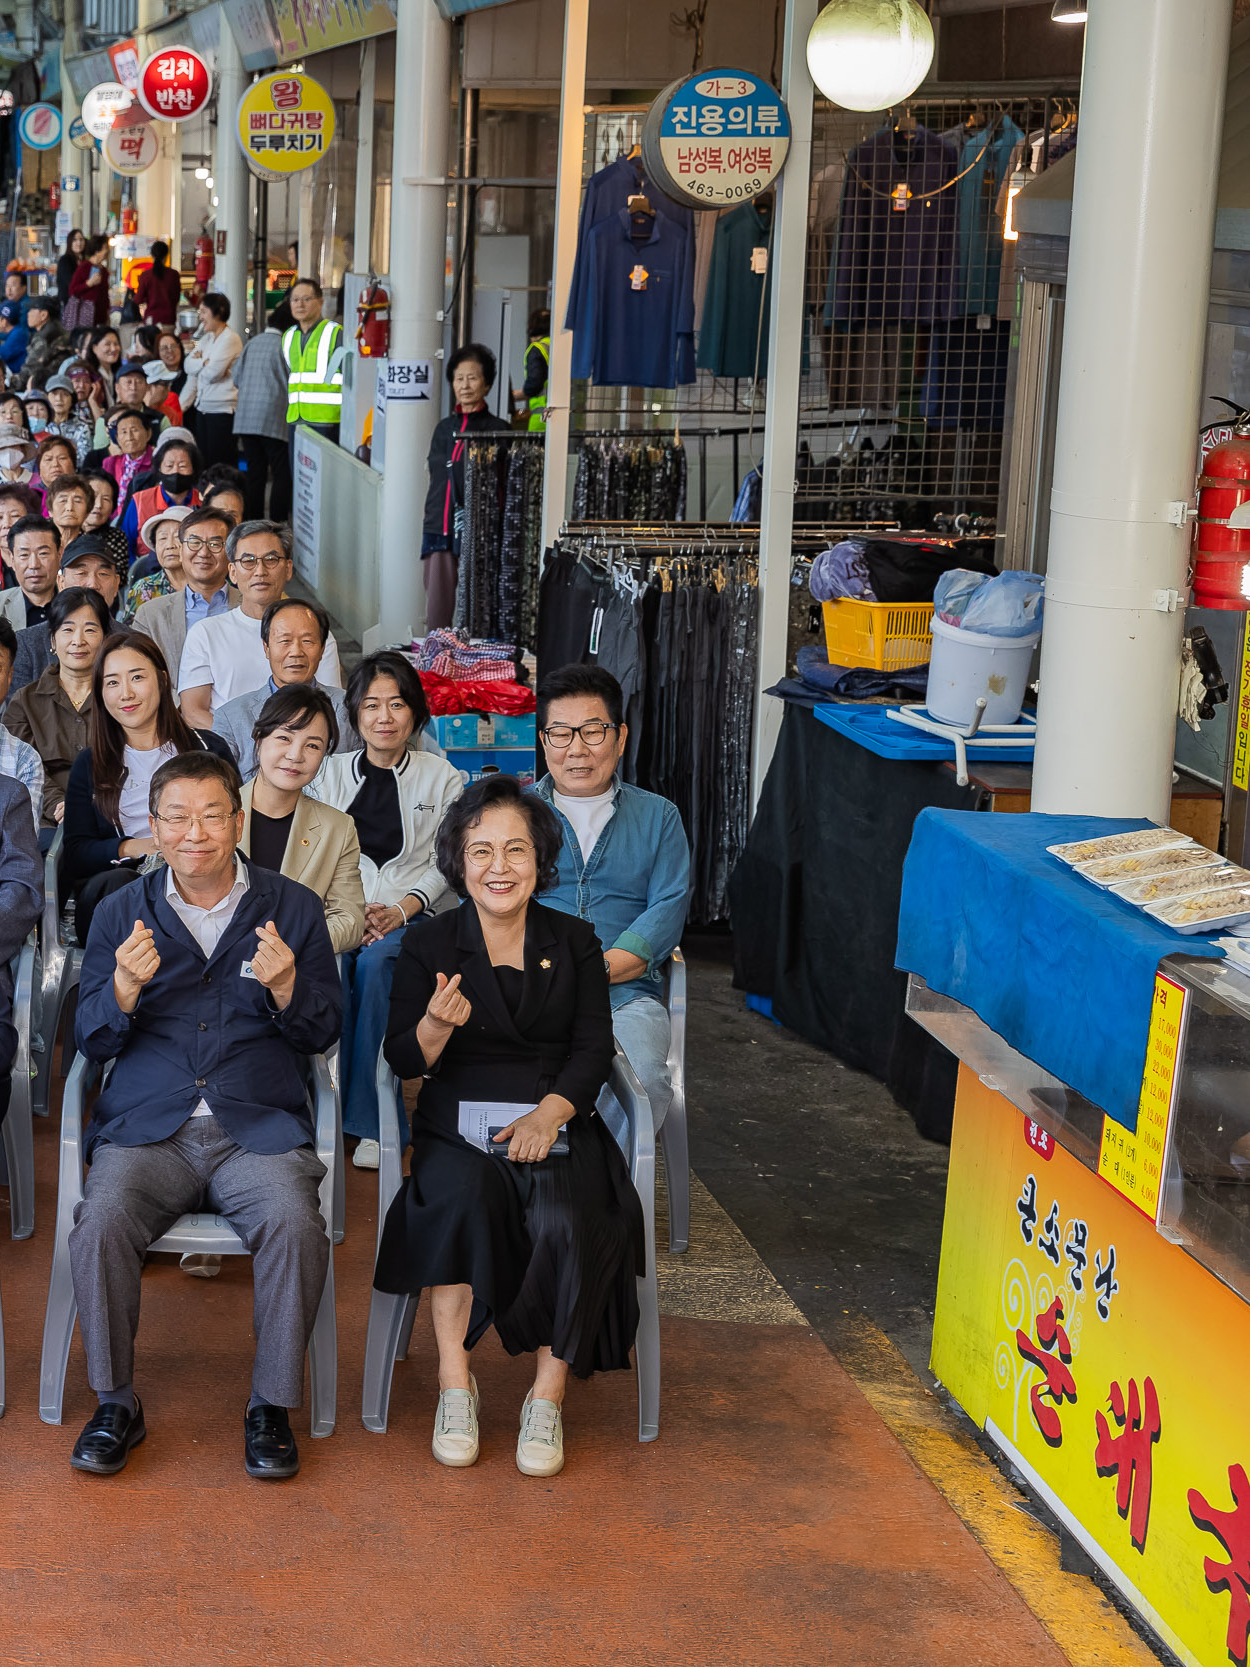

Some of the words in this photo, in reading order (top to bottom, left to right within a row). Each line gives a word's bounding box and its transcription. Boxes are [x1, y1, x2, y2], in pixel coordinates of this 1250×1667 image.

[156, 56, 195, 81] 김치
[155, 87, 195, 111] 반찬
[271, 79, 301, 110] 왕
[249, 112, 325, 132] 뼈다귀탕
[671, 105, 781, 135] 진용의류
[120, 137, 144, 160] 떡
[249, 134, 323, 153] 두루치기
[677, 147, 773, 174] 남성복.여성복
[687, 178, 762, 199] 463-0069
[388, 365, 429, 384] 화장실
[1158, 1017, 1177, 1039] 17,000
[1155, 1038, 1174, 1060] 30,000
[1152, 1060, 1171, 1082] 22,000
[1149, 1082, 1168, 1104] 12,000
[1146, 1107, 1165, 1130] 12,000
[1144, 1131, 1162, 1155] 10,000
[1143, 1158, 1159, 1179] 6,000
[1141, 1184, 1156, 1204] 4,000
